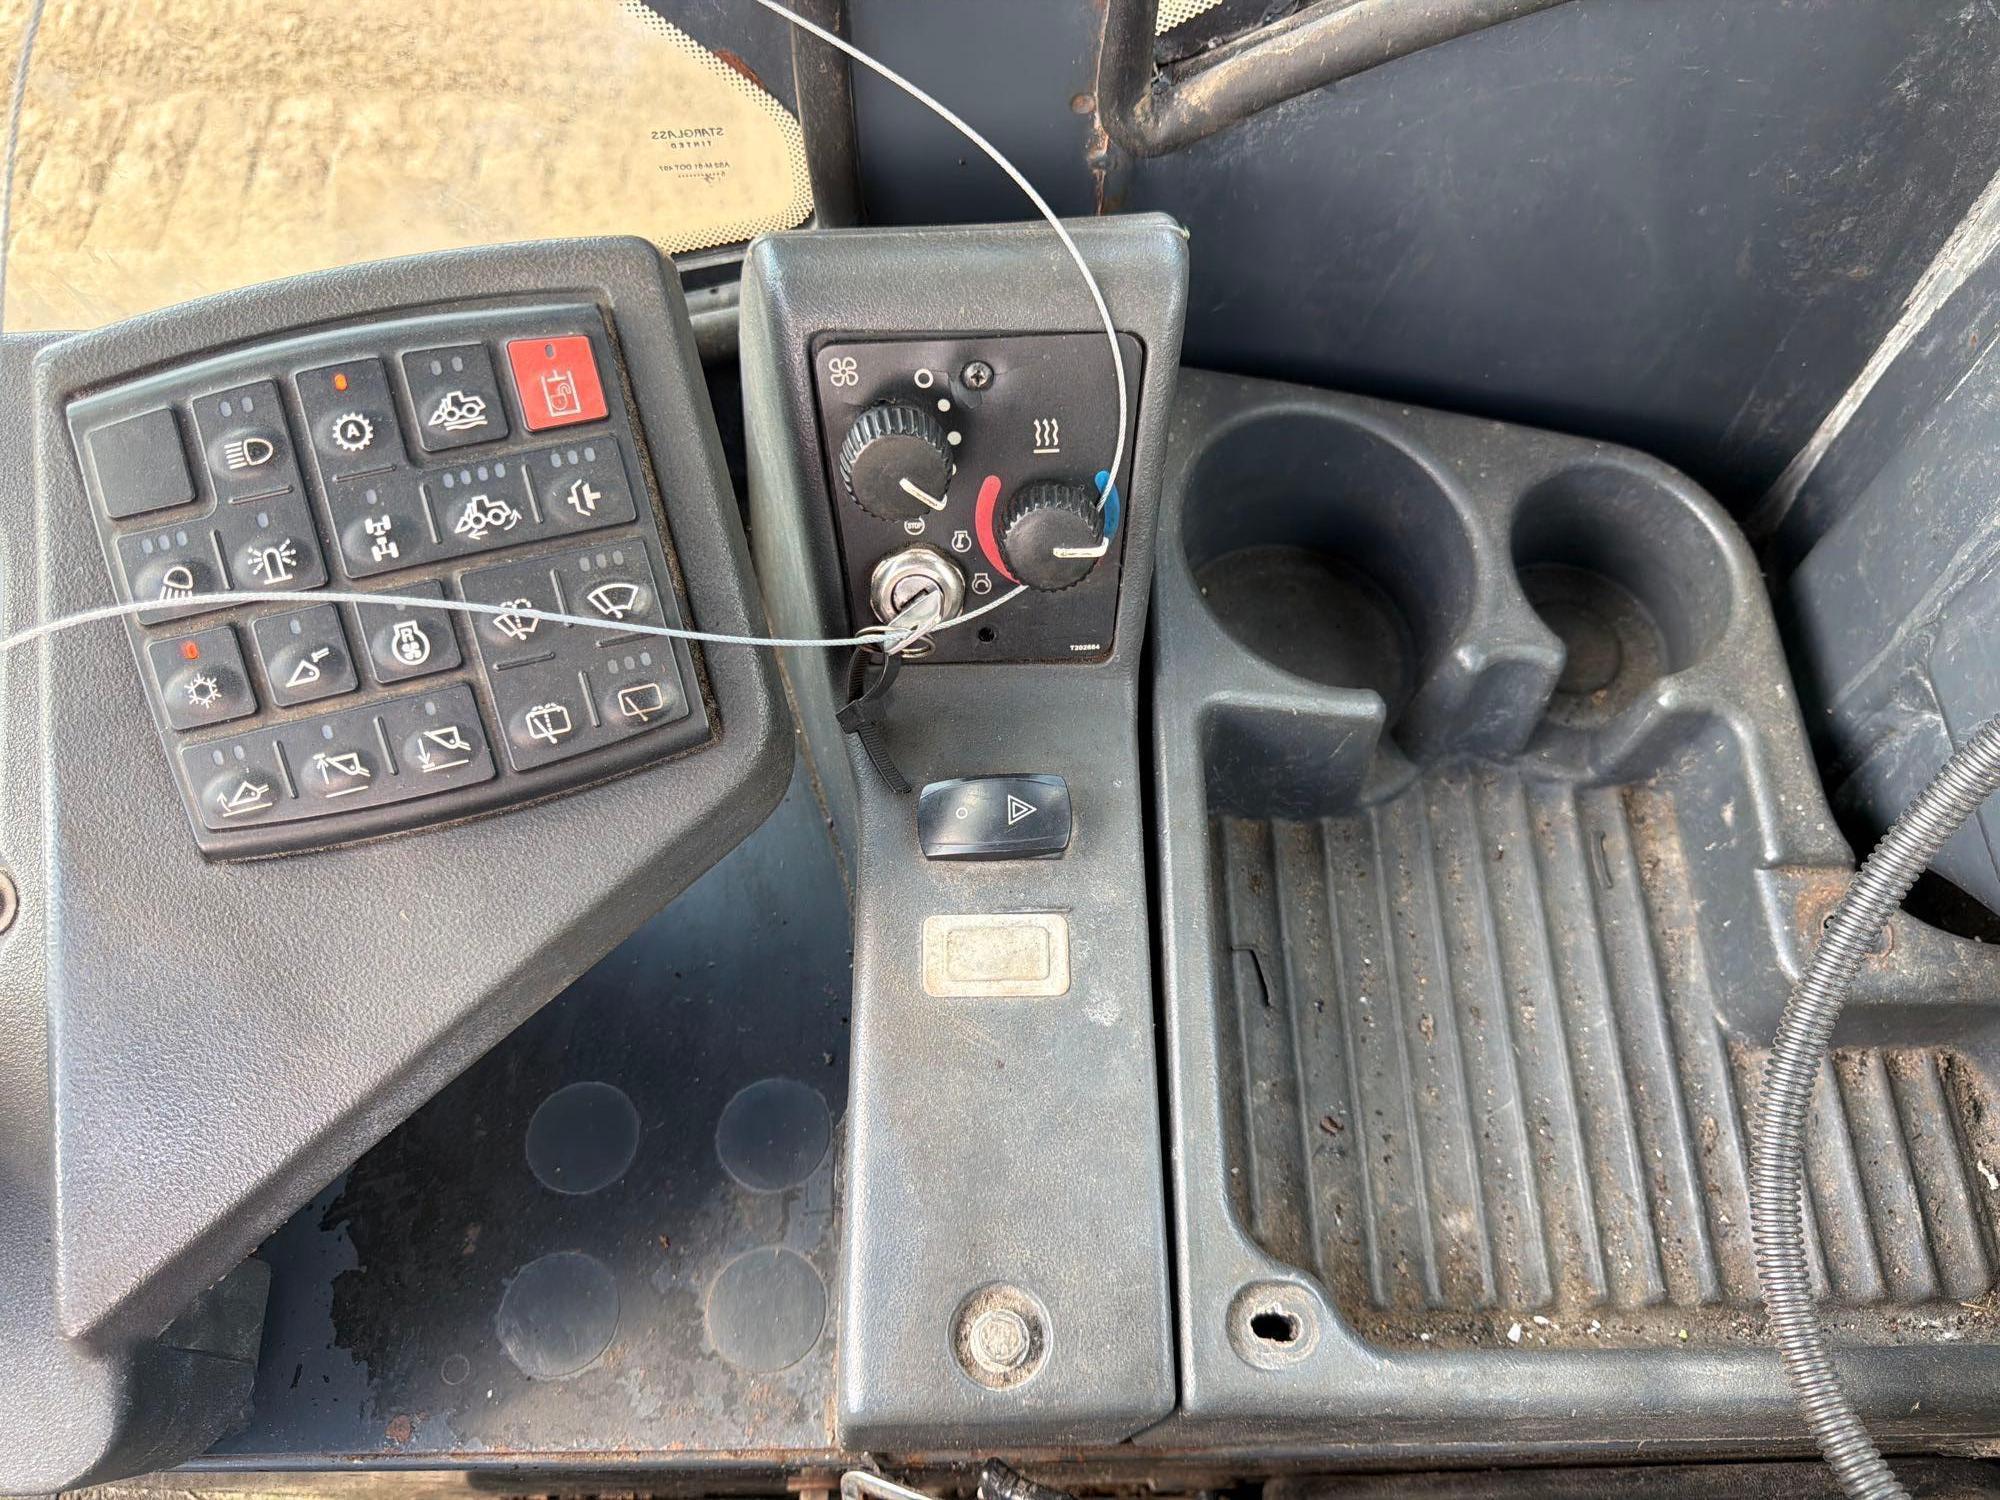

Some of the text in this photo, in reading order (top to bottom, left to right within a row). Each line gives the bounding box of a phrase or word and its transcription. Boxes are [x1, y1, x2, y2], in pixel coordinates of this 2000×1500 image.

[347, 423, 360, 438] A
[908, 521, 922, 530] STOP
[401, 628, 414, 642] R
